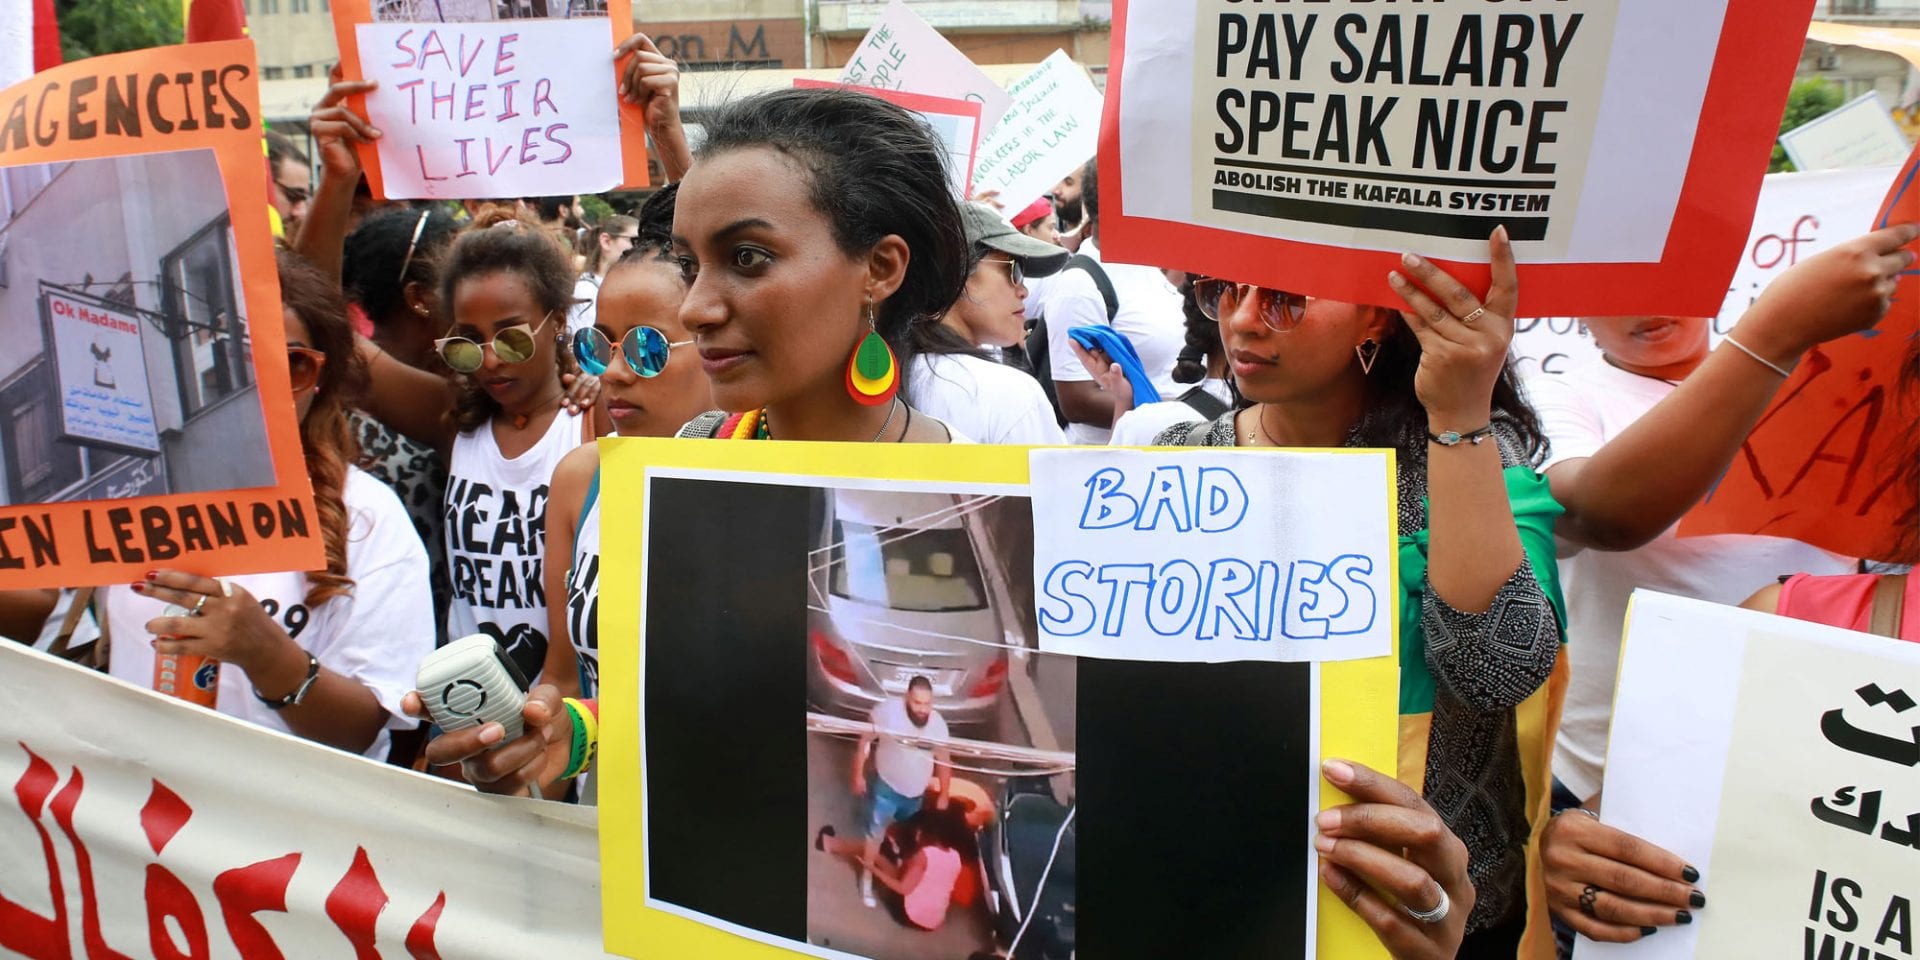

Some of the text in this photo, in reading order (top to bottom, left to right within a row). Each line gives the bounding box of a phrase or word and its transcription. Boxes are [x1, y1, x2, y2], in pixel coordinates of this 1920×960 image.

[391, 29, 519, 77] SAVE
[867, 23, 894, 50] THE
[870, 42, 906, 88] OPLE
[1216, 13, 1584, 88] PAY SALARY
[0, 63, 252, 151] AGENCIES
[396, 78, 558, 125] THEIR
[1214, 88, 1568, 174] SPEAK NICE
[416, 123, 573, 181] LIVES
[997, 149, 1044, 187] LABOR
[1042, 113, 1079, 148] LAW
[1214, 169, 1551, 212] ABOLISH THE KAFALA SYSTEM
[53, 300, 138, 335] Ok Madame
[1079, 465, 1249, 532] BAD
[0, 498, 310, 570] IN LEBANON
[453, 555, 547, 609] REAK
[1038, 554, 1377, 641] STORIES
[1808, 869, 1862, 933] IS
